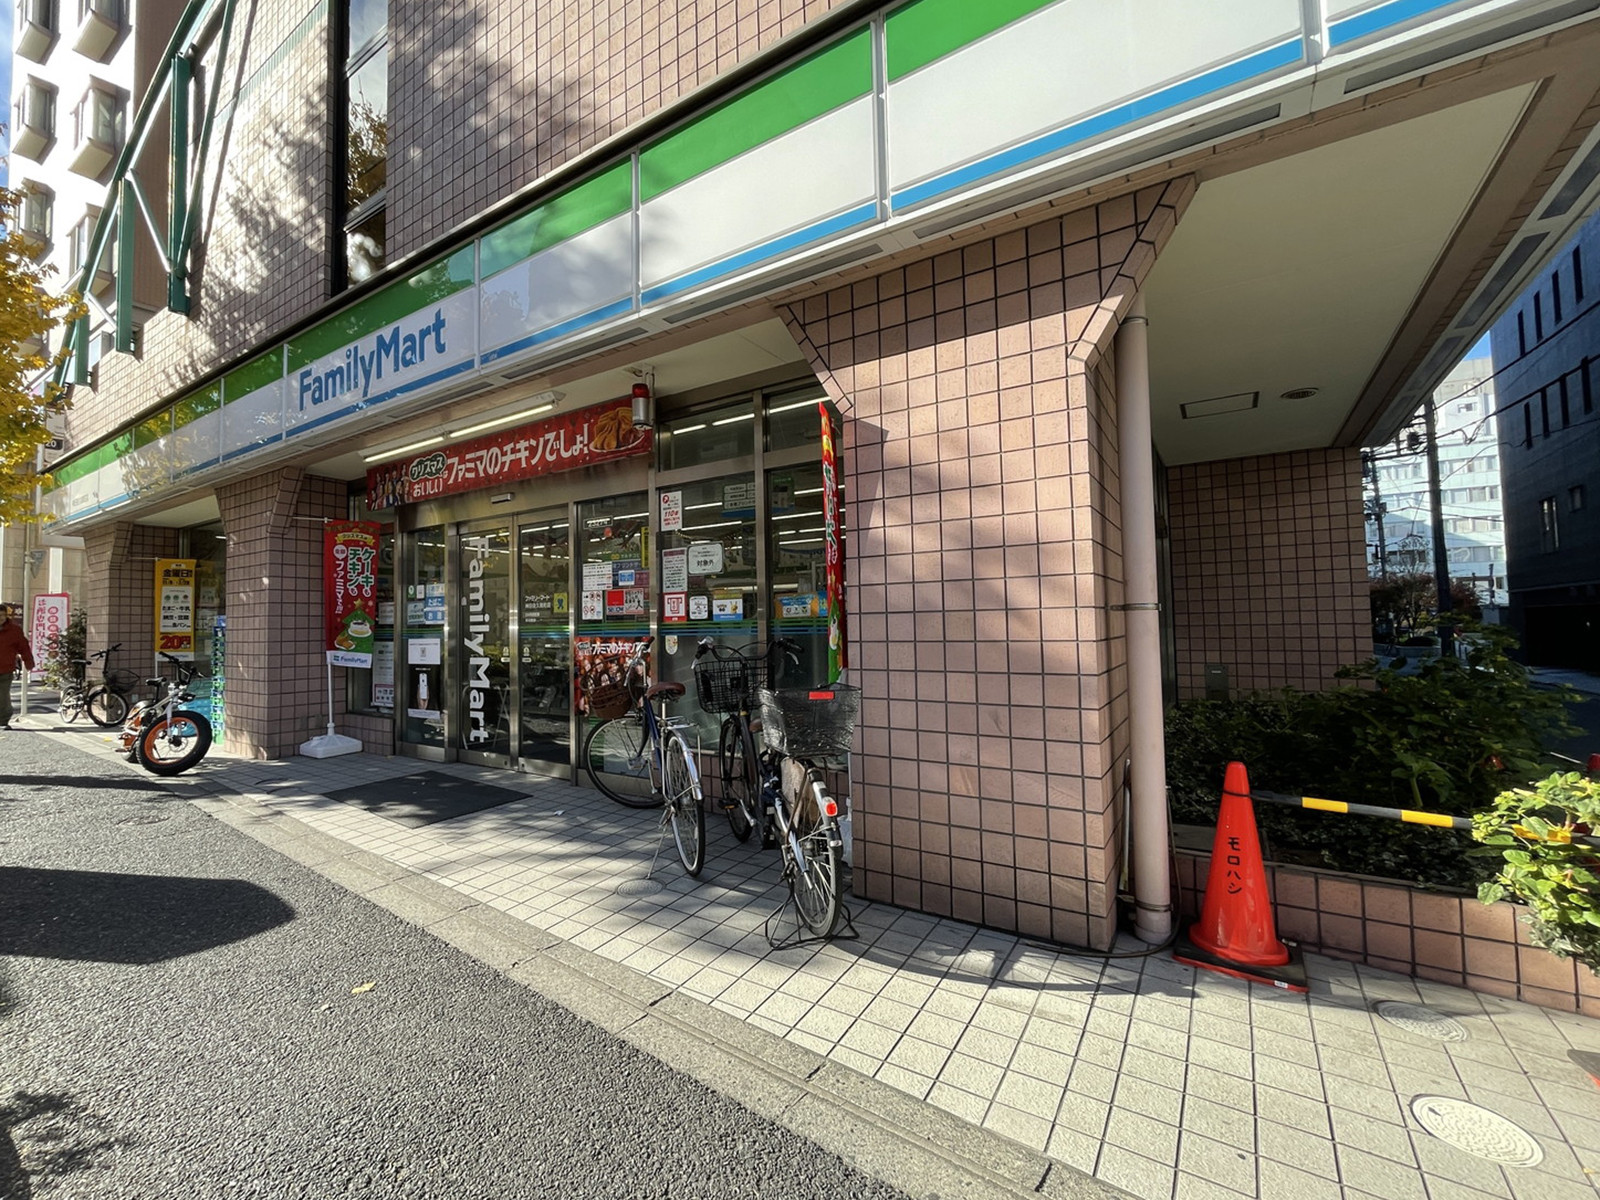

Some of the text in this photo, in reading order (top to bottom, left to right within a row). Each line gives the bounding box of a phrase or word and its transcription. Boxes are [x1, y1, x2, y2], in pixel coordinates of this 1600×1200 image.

[299, 307, 446, 412] FamilyMart
[413, 478, 444, 497] おいしい
[463, 537, 491, 743] FamilyMart
[1227, 836, 1242, 894] モロハシ
